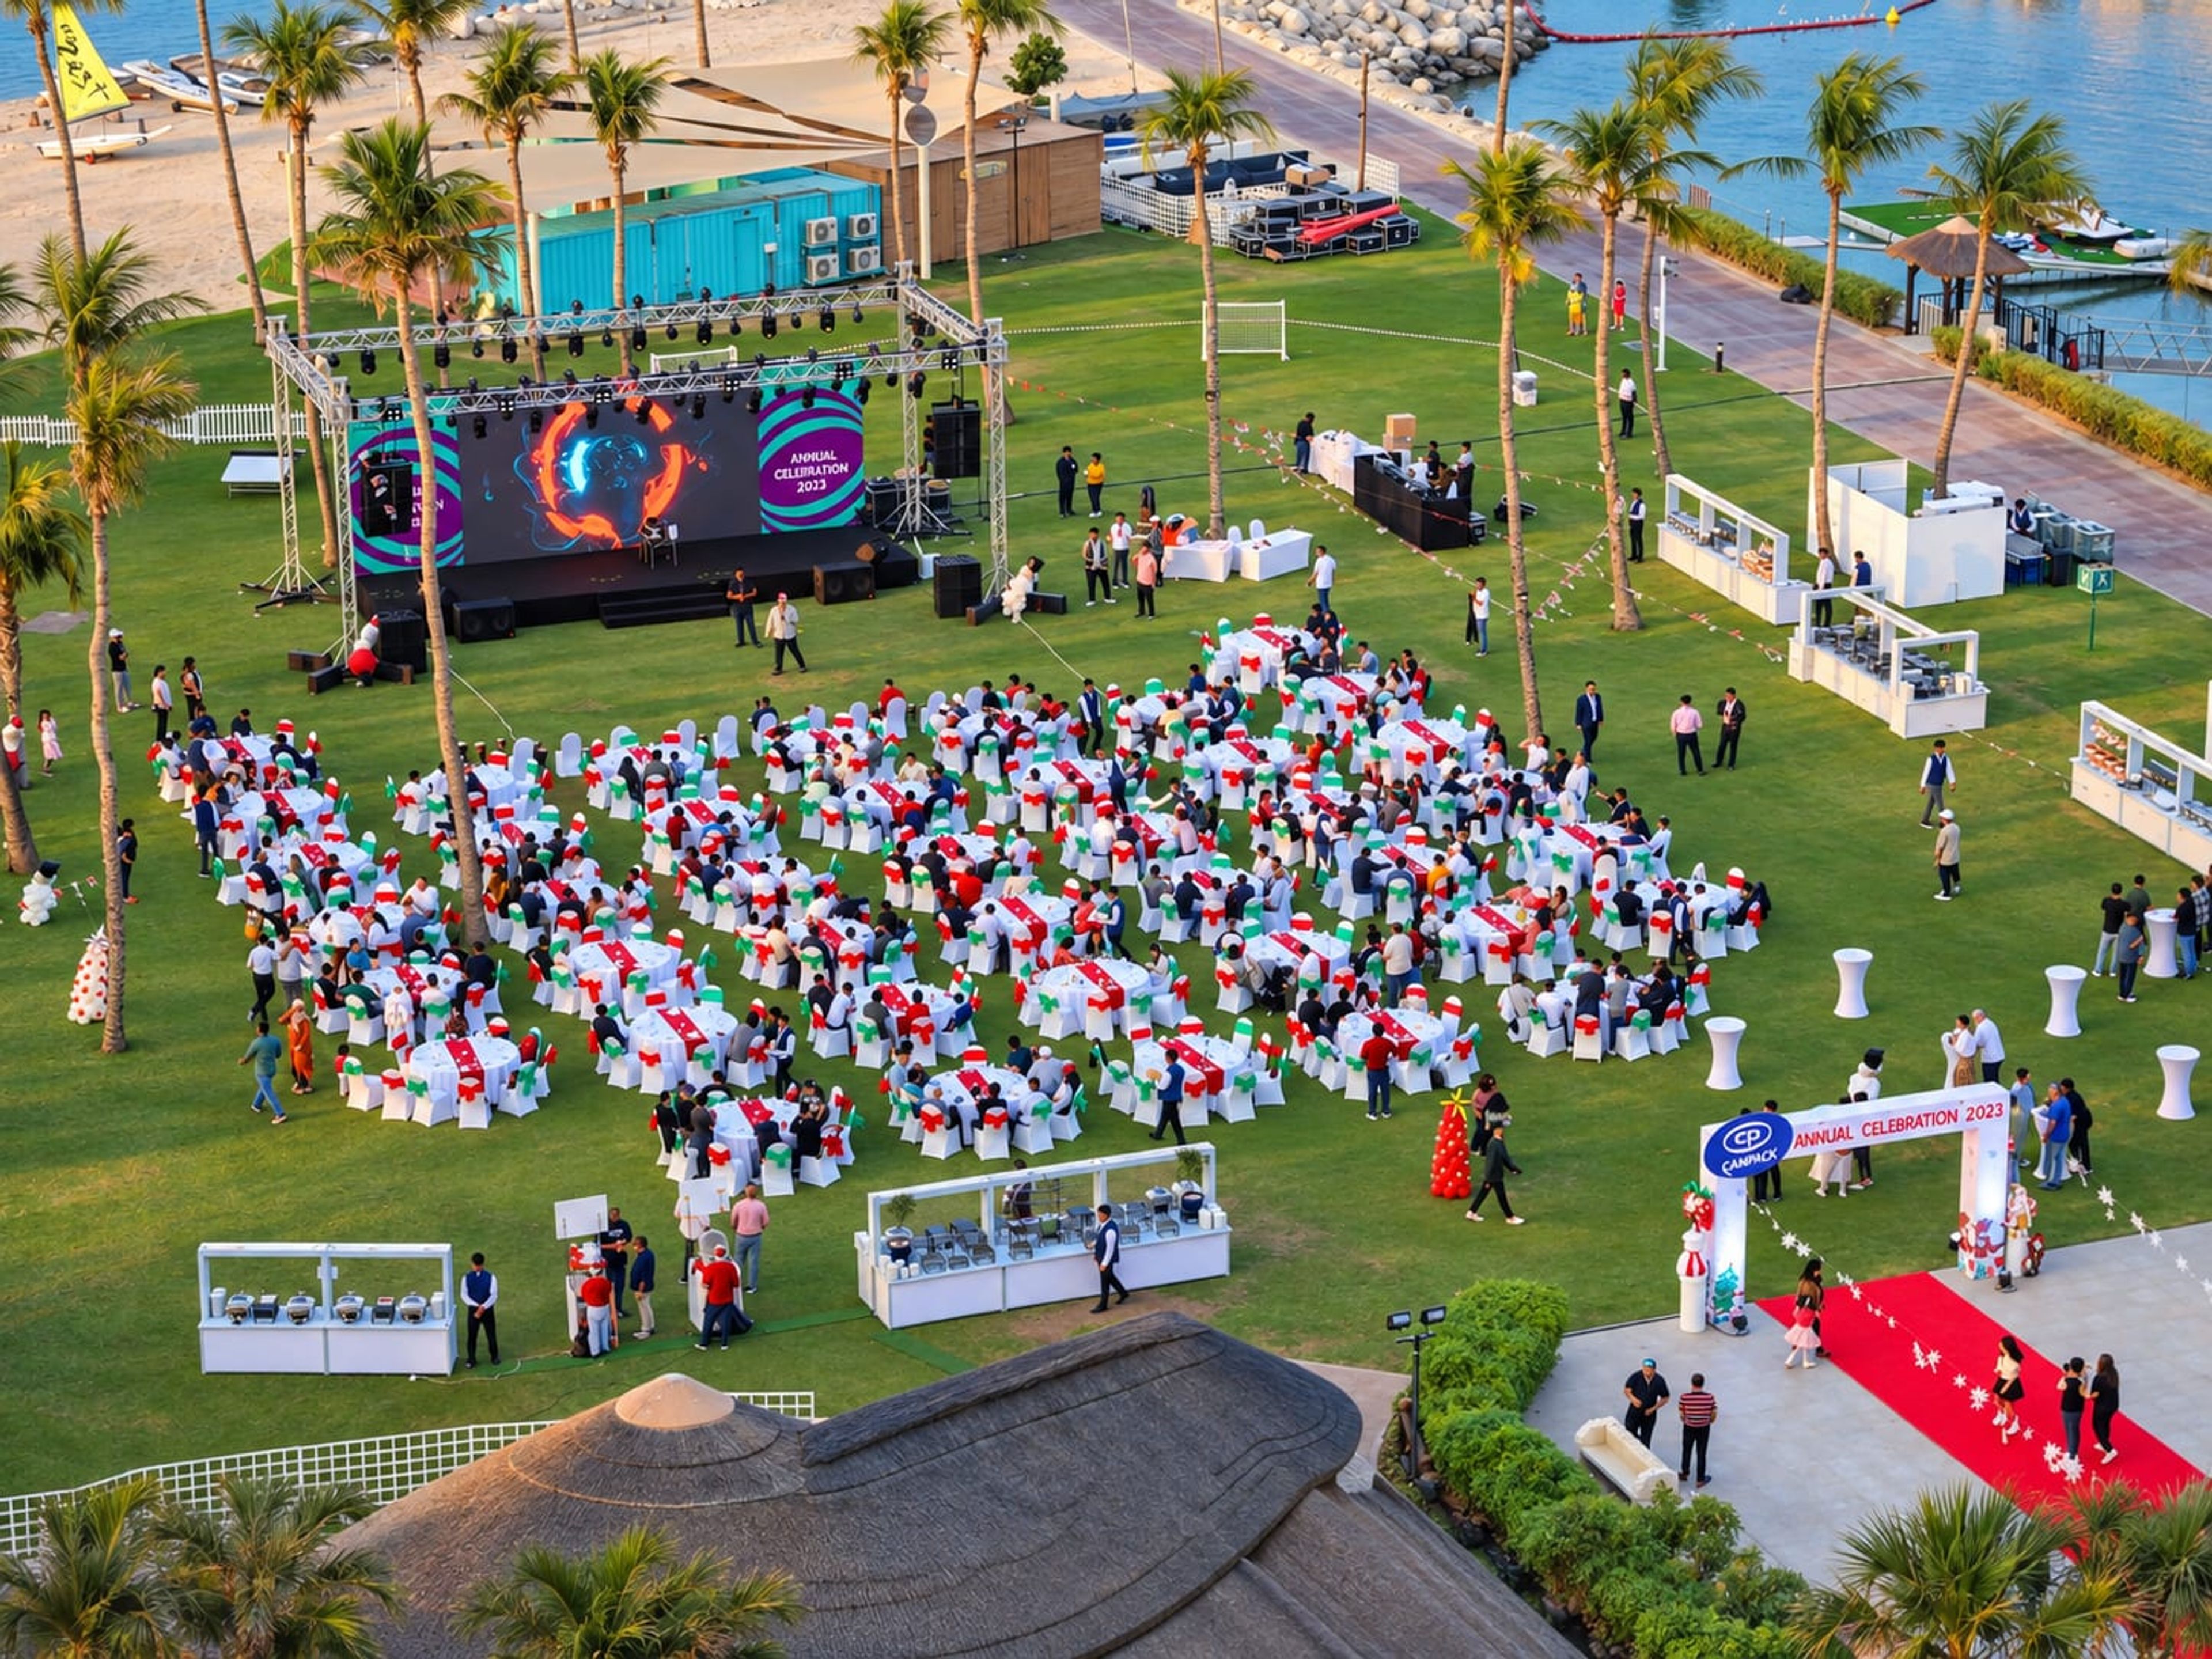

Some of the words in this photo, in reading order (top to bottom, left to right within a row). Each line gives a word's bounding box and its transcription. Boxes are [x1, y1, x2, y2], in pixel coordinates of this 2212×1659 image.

[791, 450, 837, 464] ANNUAL
[1794, 1125, 1853, 1149] ANNUAL
[1862, 1109, 1958, 1137] CELEBRATION
[1965, 1103, 2003, 1122] 2023
[1722, 1147, 1778, 1176] CANPACK
